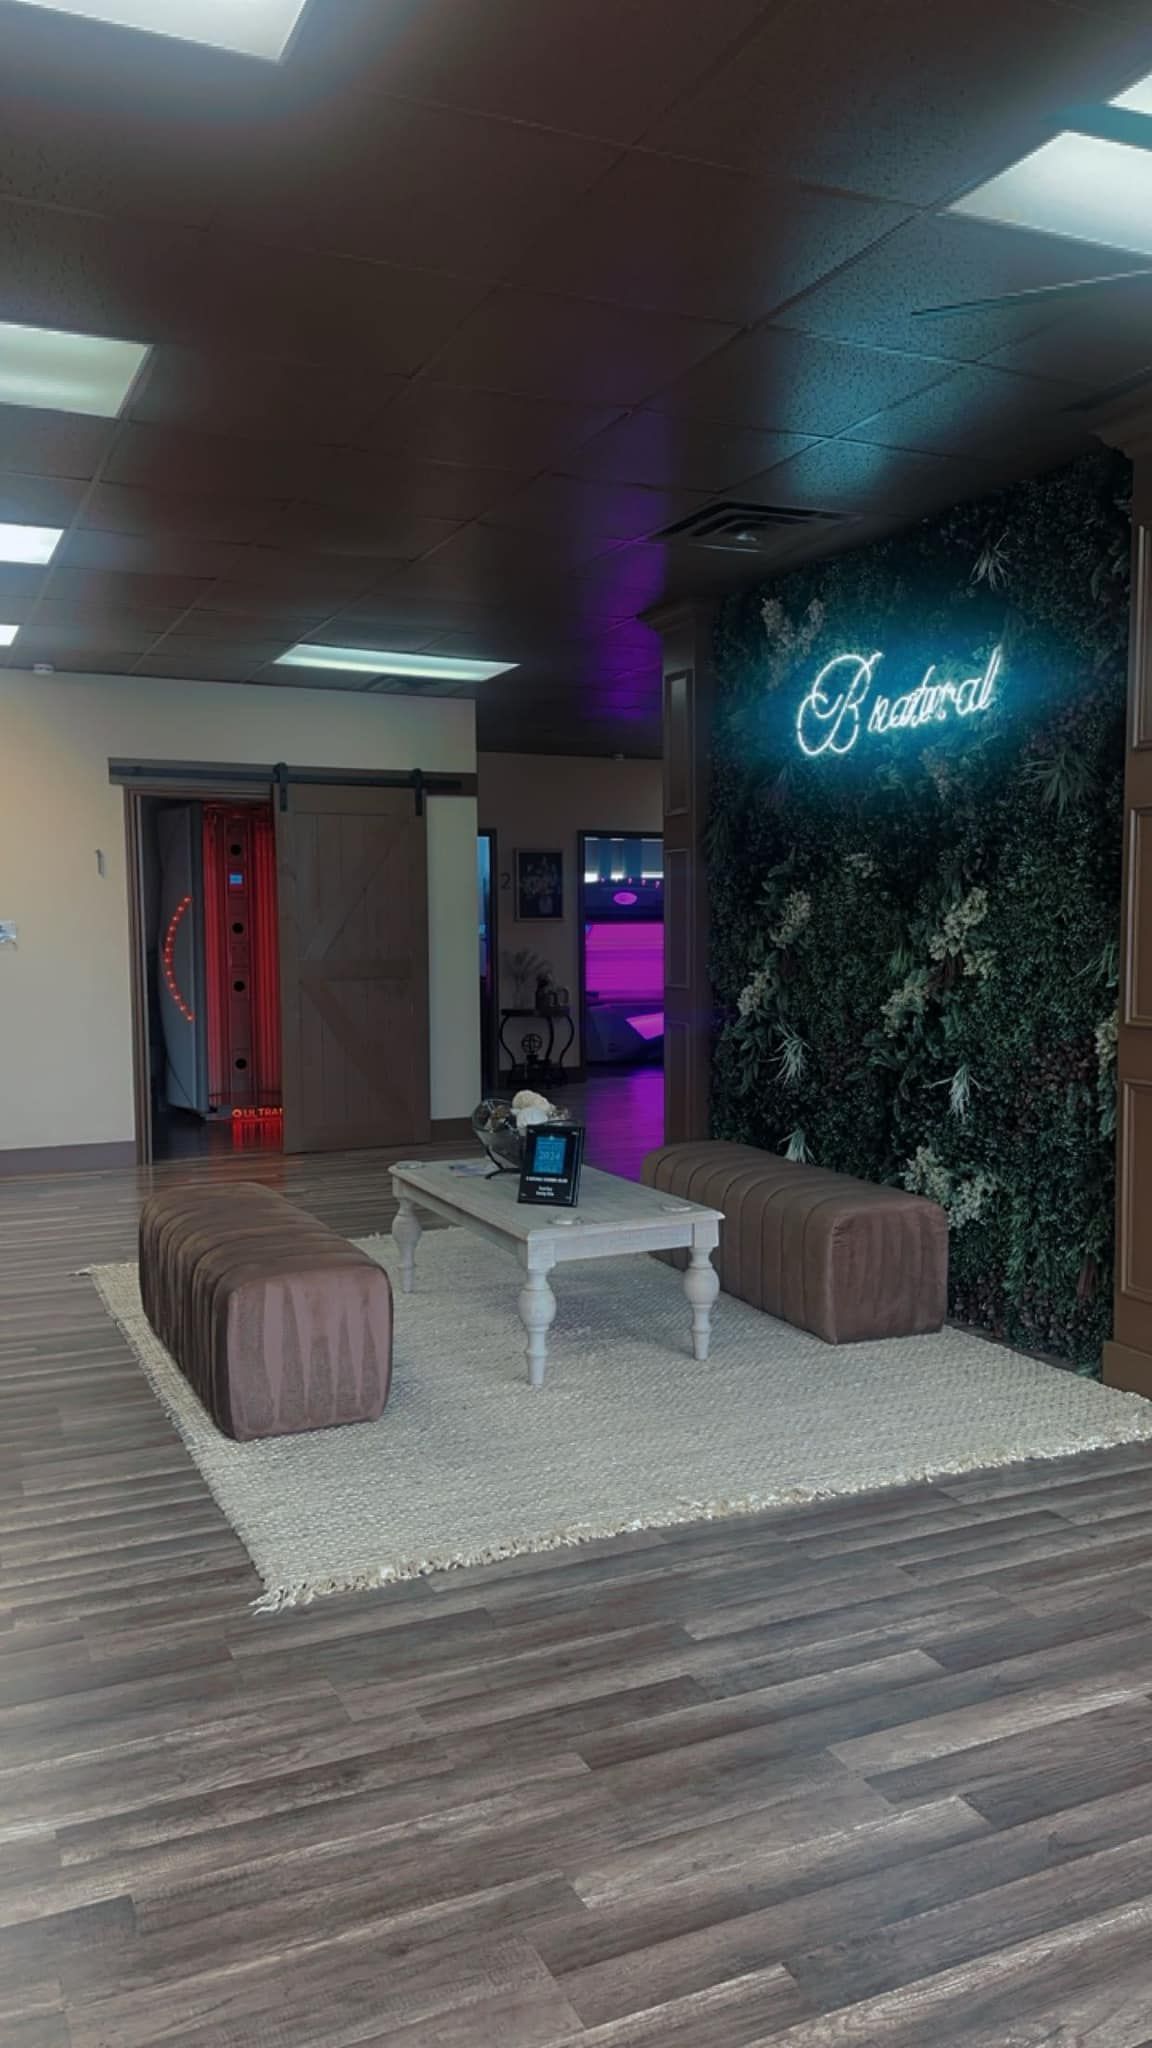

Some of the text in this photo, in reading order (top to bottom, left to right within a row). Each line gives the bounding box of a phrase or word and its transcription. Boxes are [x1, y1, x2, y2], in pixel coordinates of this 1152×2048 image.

[797, 643, 1002, 756] B natural
[500, 871, 512, 889] 2
